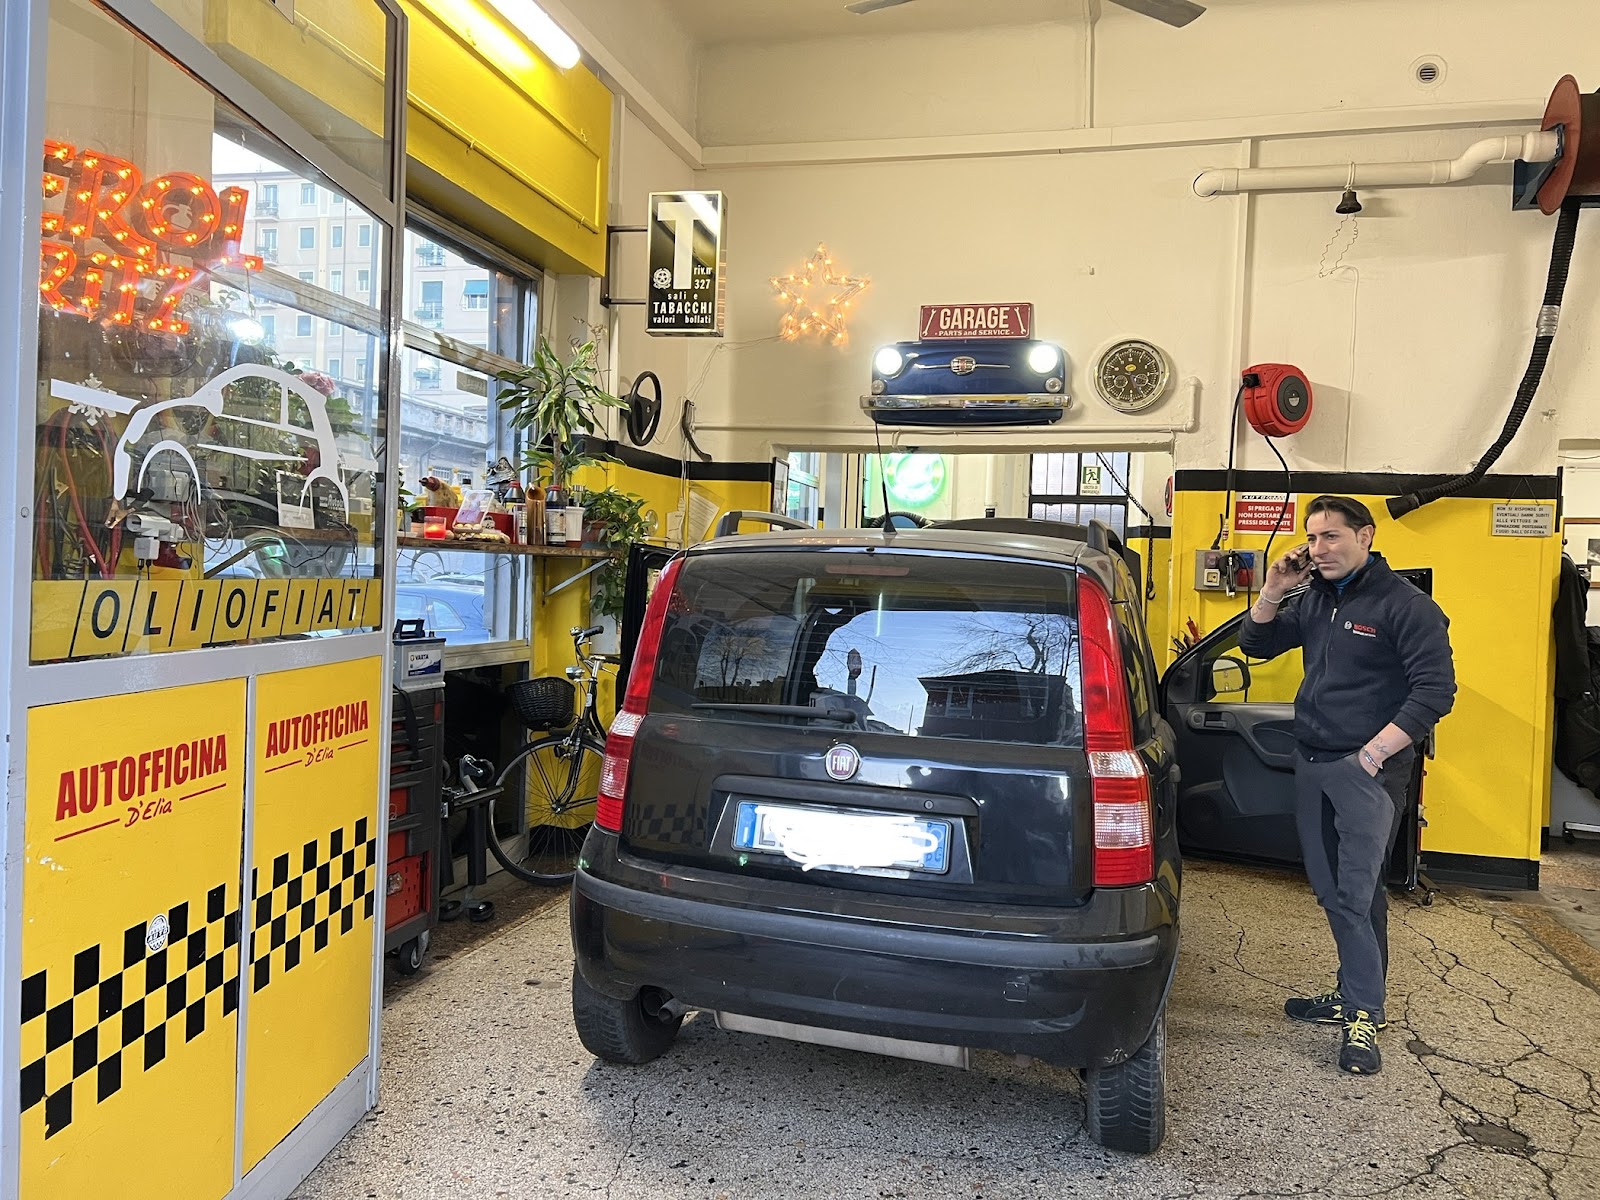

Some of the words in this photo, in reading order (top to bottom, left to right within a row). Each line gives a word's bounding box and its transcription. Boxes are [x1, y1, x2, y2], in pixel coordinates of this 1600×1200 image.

[657, 201, 712, 289] T
[694, 279, 711, 290] 327
[667, 291, 687, 300] sali
[653, 302, 712, 314] TABACCHI
[653, 315, 675, 324] valori
[685, 315, 711, 324] bollati
[940, 307, 1010, 330] GARAGE
[265, 700, 369, 758] AUTOFFICINA
[304, 748, 334, 768] D'Elia
[832, 755, 853, 773] FIAT
[55, 733, 227, 822] AUTOFFICINA
[124, 799, 173, 828] D'Elia
